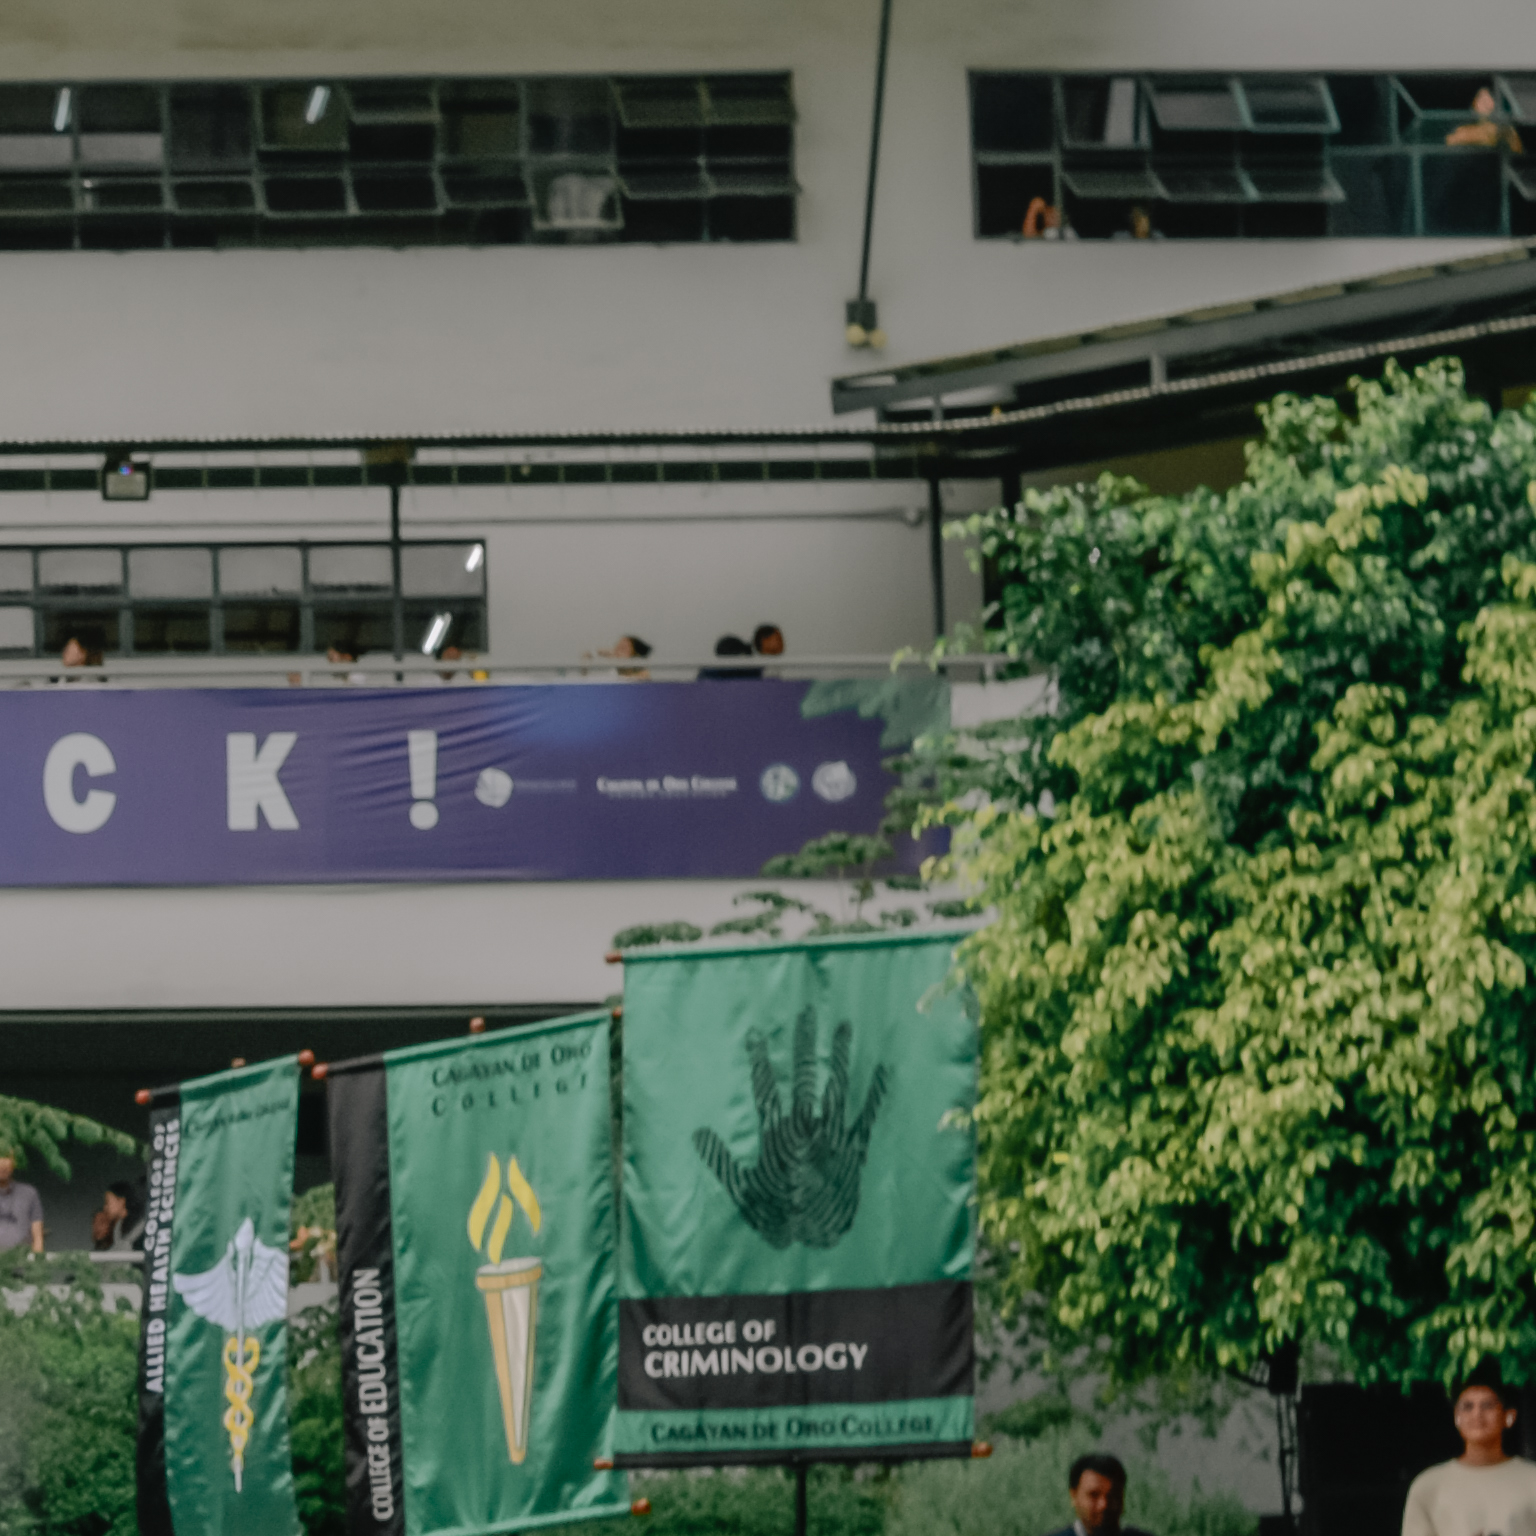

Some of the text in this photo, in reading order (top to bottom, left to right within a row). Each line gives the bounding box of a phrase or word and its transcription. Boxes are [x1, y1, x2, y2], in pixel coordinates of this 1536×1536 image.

[143, 1124, 166, 1252] COLLEGE OF
[145, 1118, 181, 1394] ALLIED HEALTH SCIENCES
[353, 1267, 394, 1522] COLLEGE OF EDUCATION
[642, 1318, 777, 1346] COLLEGE OF
[644, 1342, 868, 1378] CRIMINOLOGY
